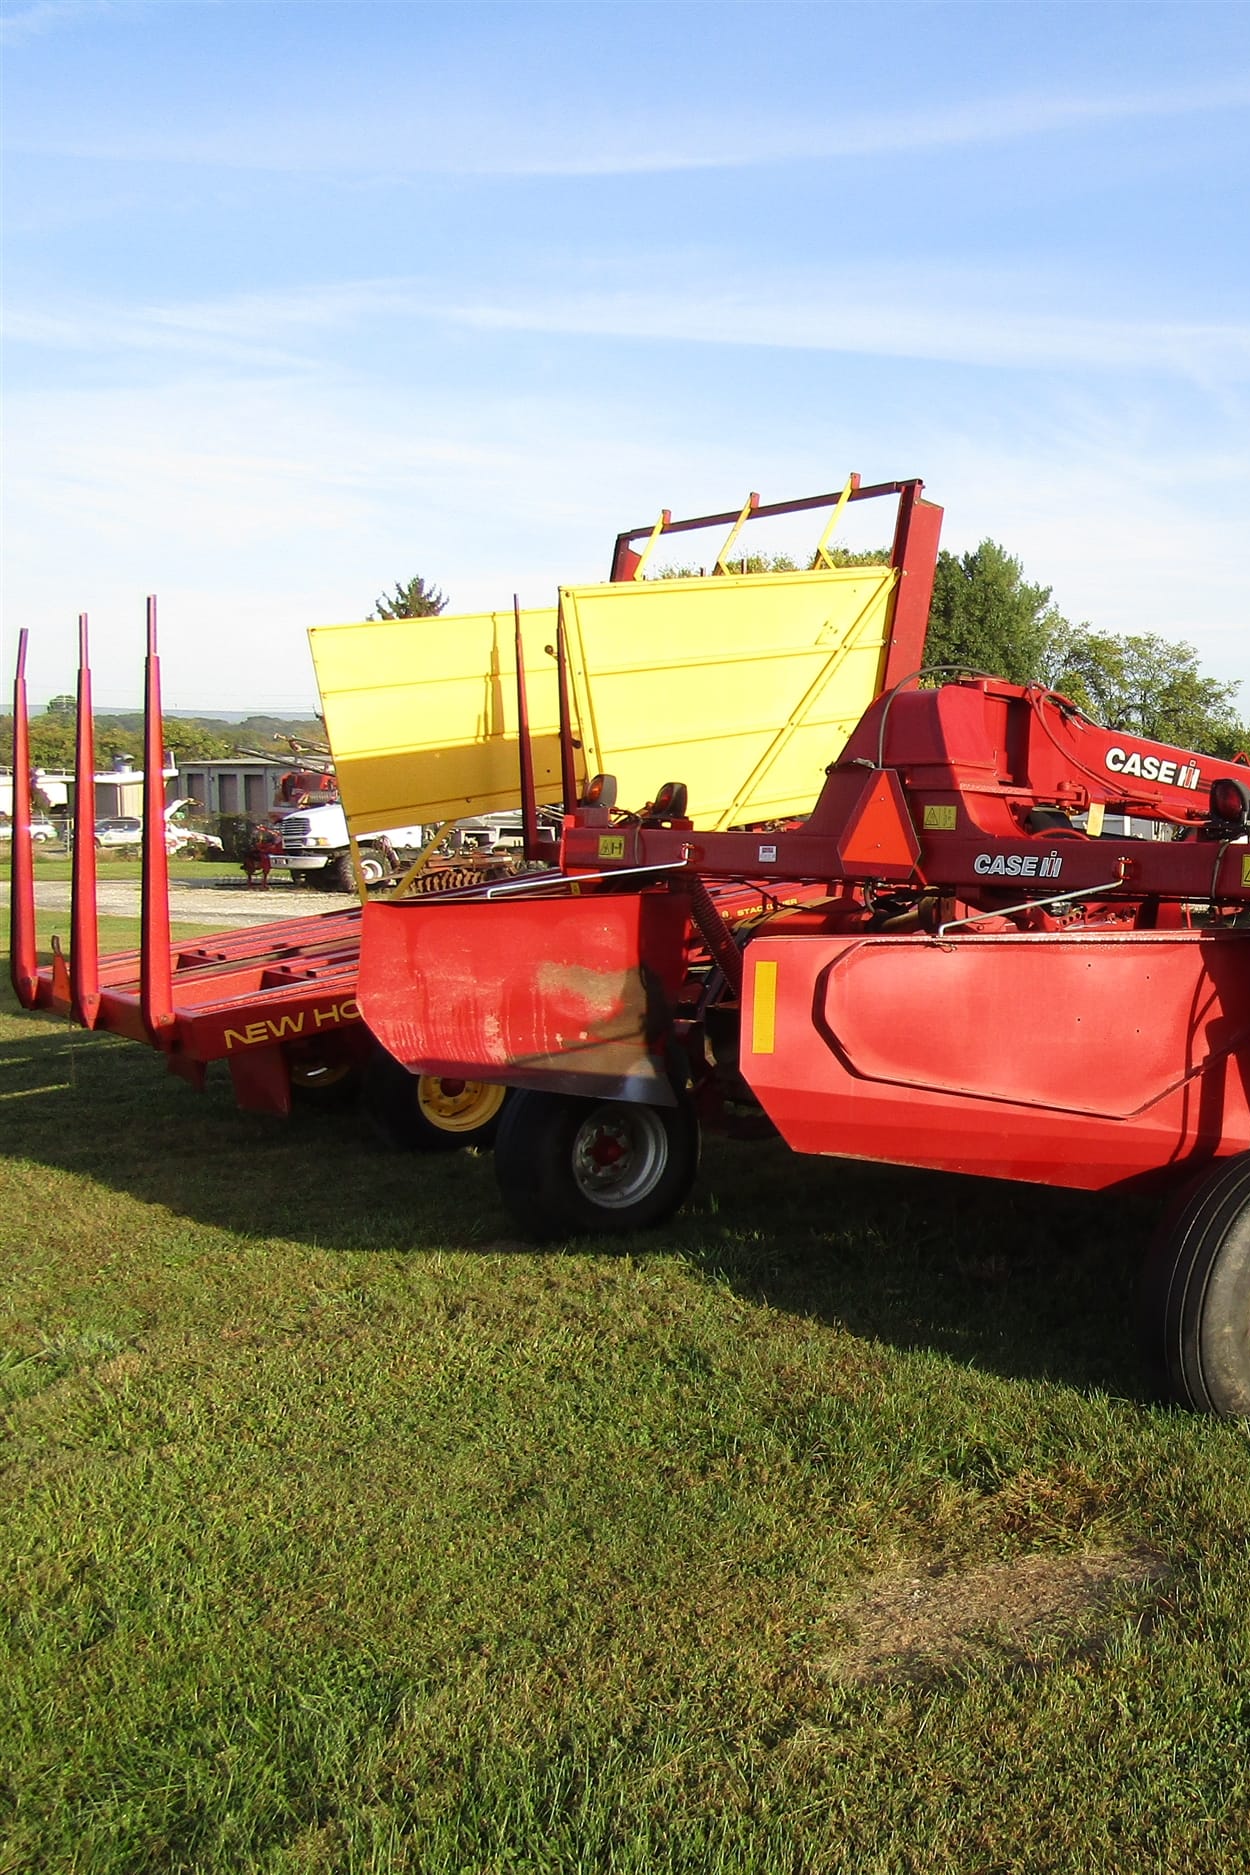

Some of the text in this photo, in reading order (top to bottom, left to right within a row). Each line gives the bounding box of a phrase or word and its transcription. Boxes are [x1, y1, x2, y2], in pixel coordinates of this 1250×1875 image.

[1105, 747, 1178, 785] CASE
[974, 853, 1039, 877] CASE
[223, 1011, 305, 1049] NEW
